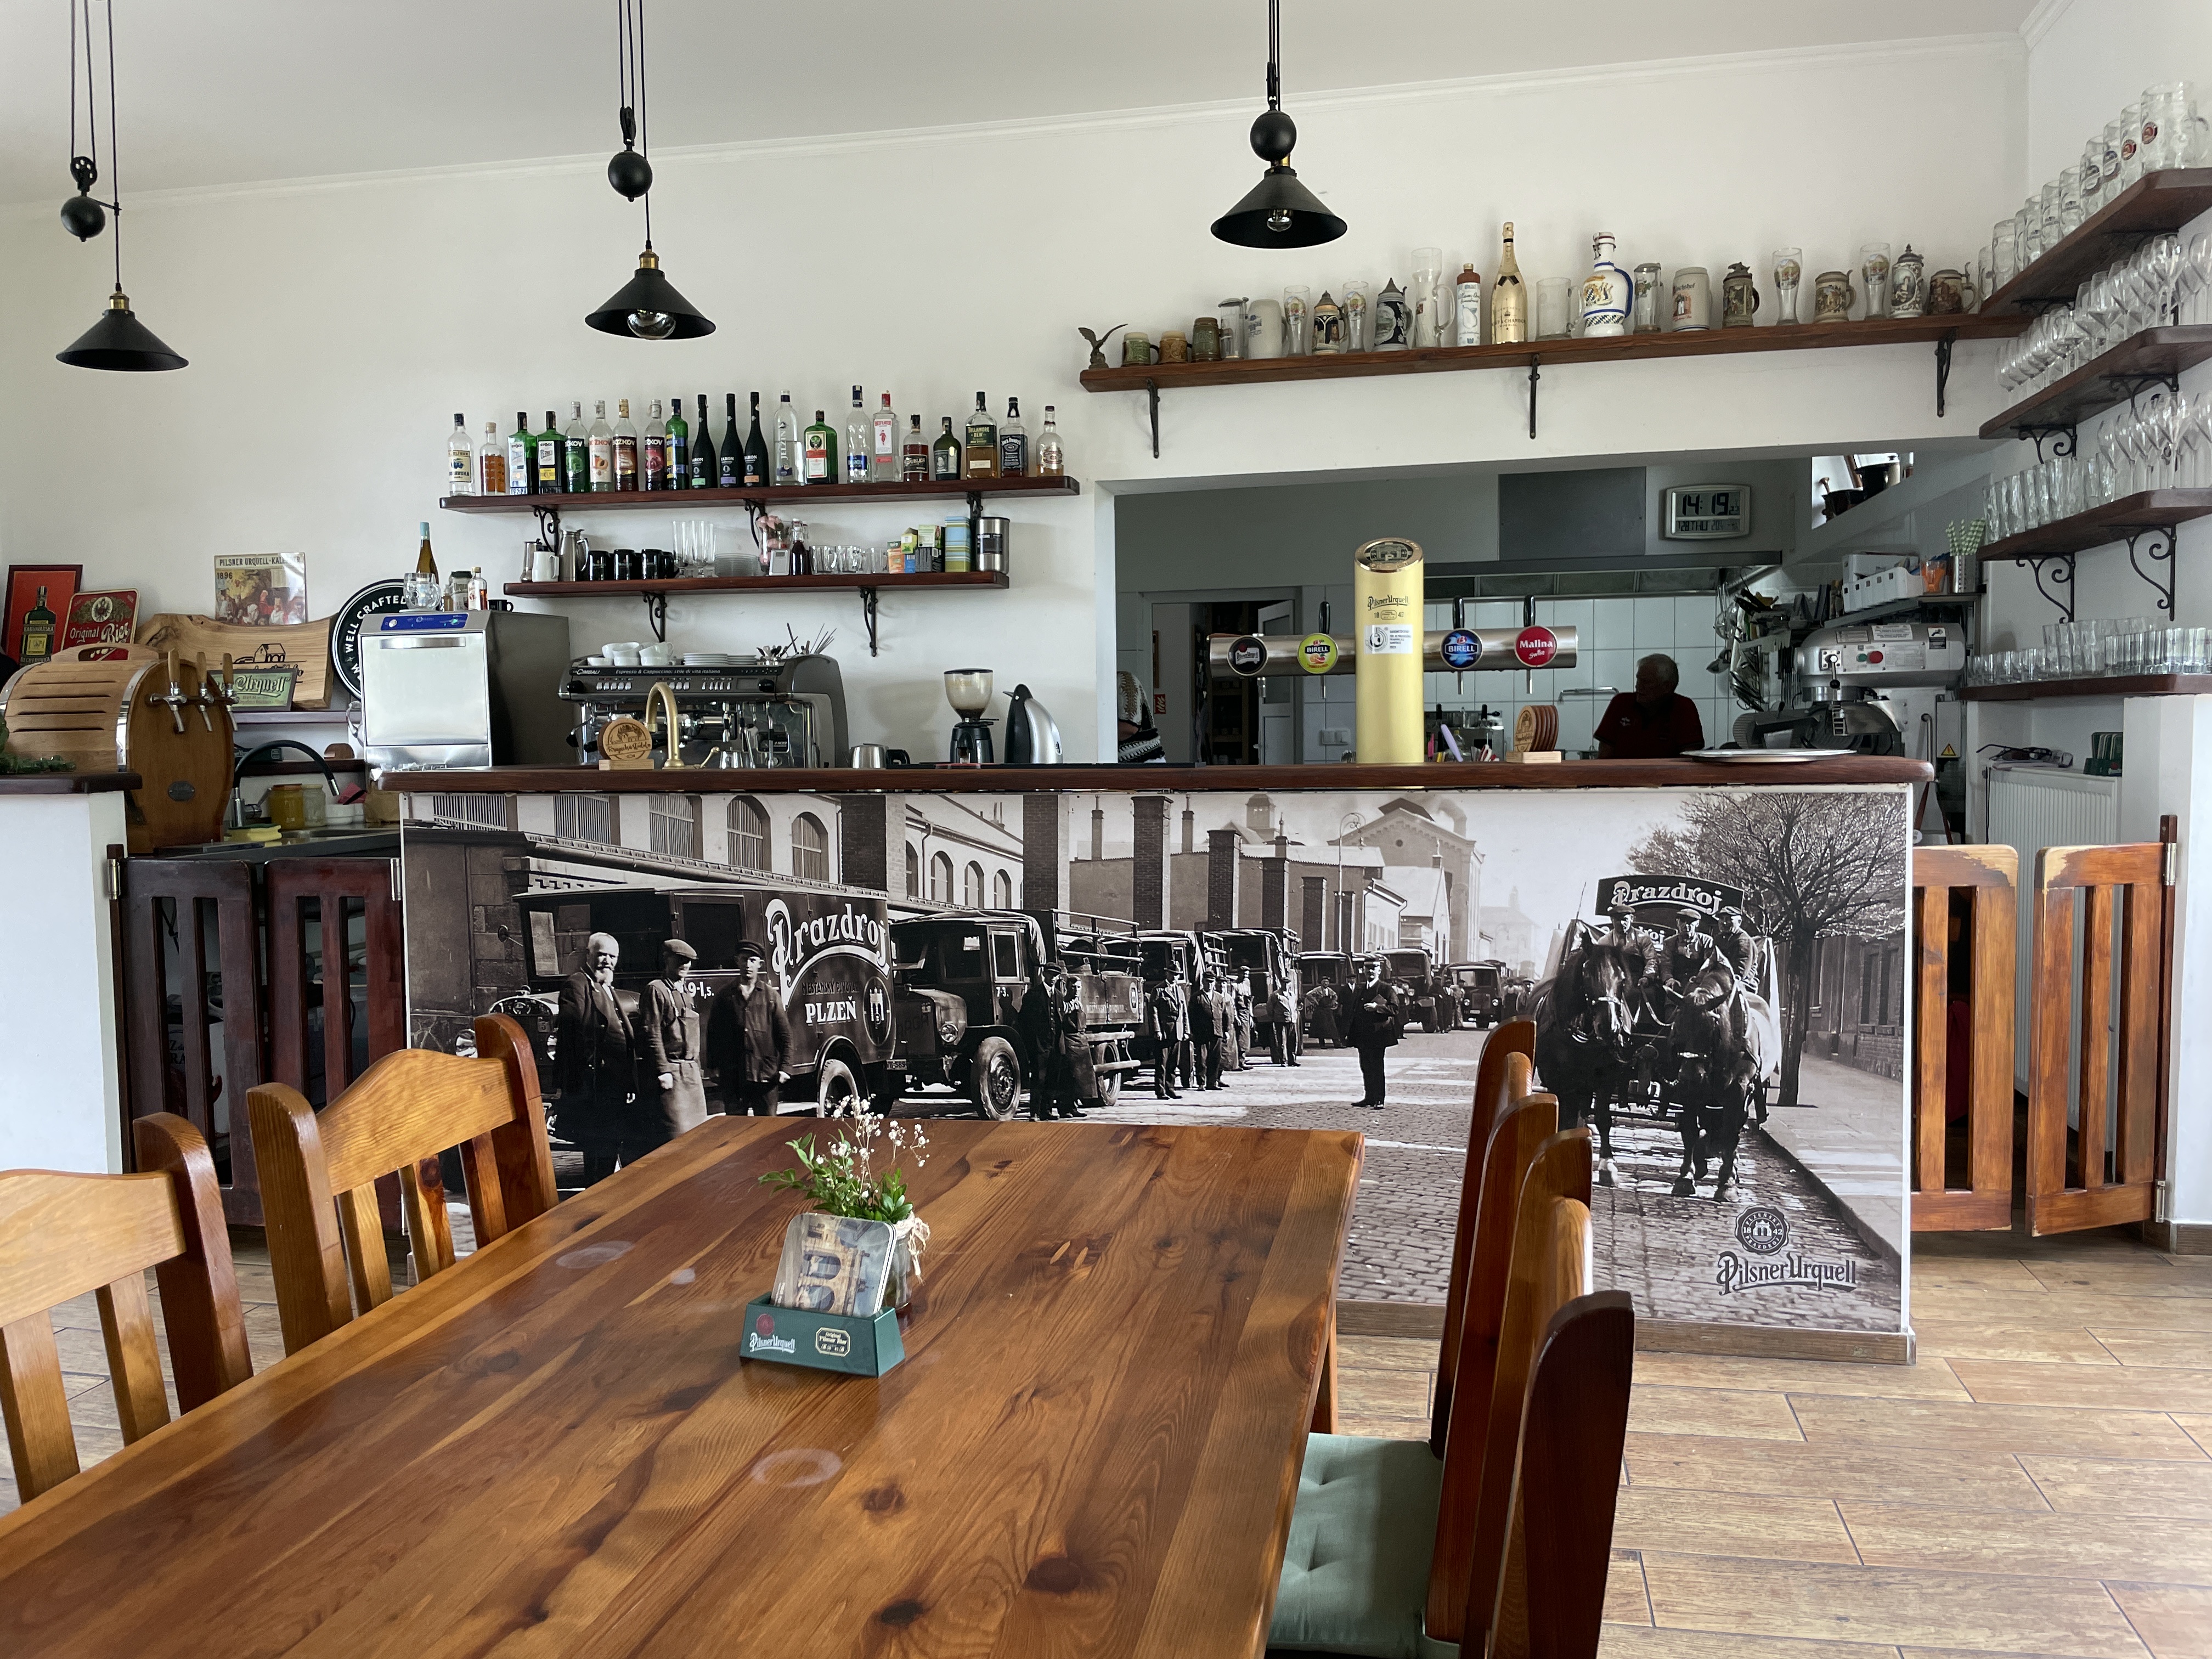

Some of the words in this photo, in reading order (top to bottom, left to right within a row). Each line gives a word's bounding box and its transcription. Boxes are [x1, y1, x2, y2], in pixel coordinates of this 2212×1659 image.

[780, 430, 788, 460] JELZIN
[1682, 493, 1729, 516] 14:19
[219, 558, 243, 566] PILSNER
[357, 595, 407, 619] CRAFTED
[1367, 596, 1389, 611] Pilsner
[1387, 594, 1408, 606] Urquell
[70, 626, 100, 644] Original
[345, 623, 359, 653] WELL
[1520, 639, 1553, 648] Malina
[1607, 881, 1723, 916] Prazdroj
[765, 898, 887, 1012] Prazdroj
[805, 996, 857, 1026] PLZEŇ
[1745, 1235, 1780, 1249] PRAZDROJ
[1716, 1251, 1788, 1296] Pilsner
[1786, 1251, 1857, 1292] Urquell
[749, 1332, 774, 1353] Pilsner
[772, 1334, 795, 1353] Urquell
